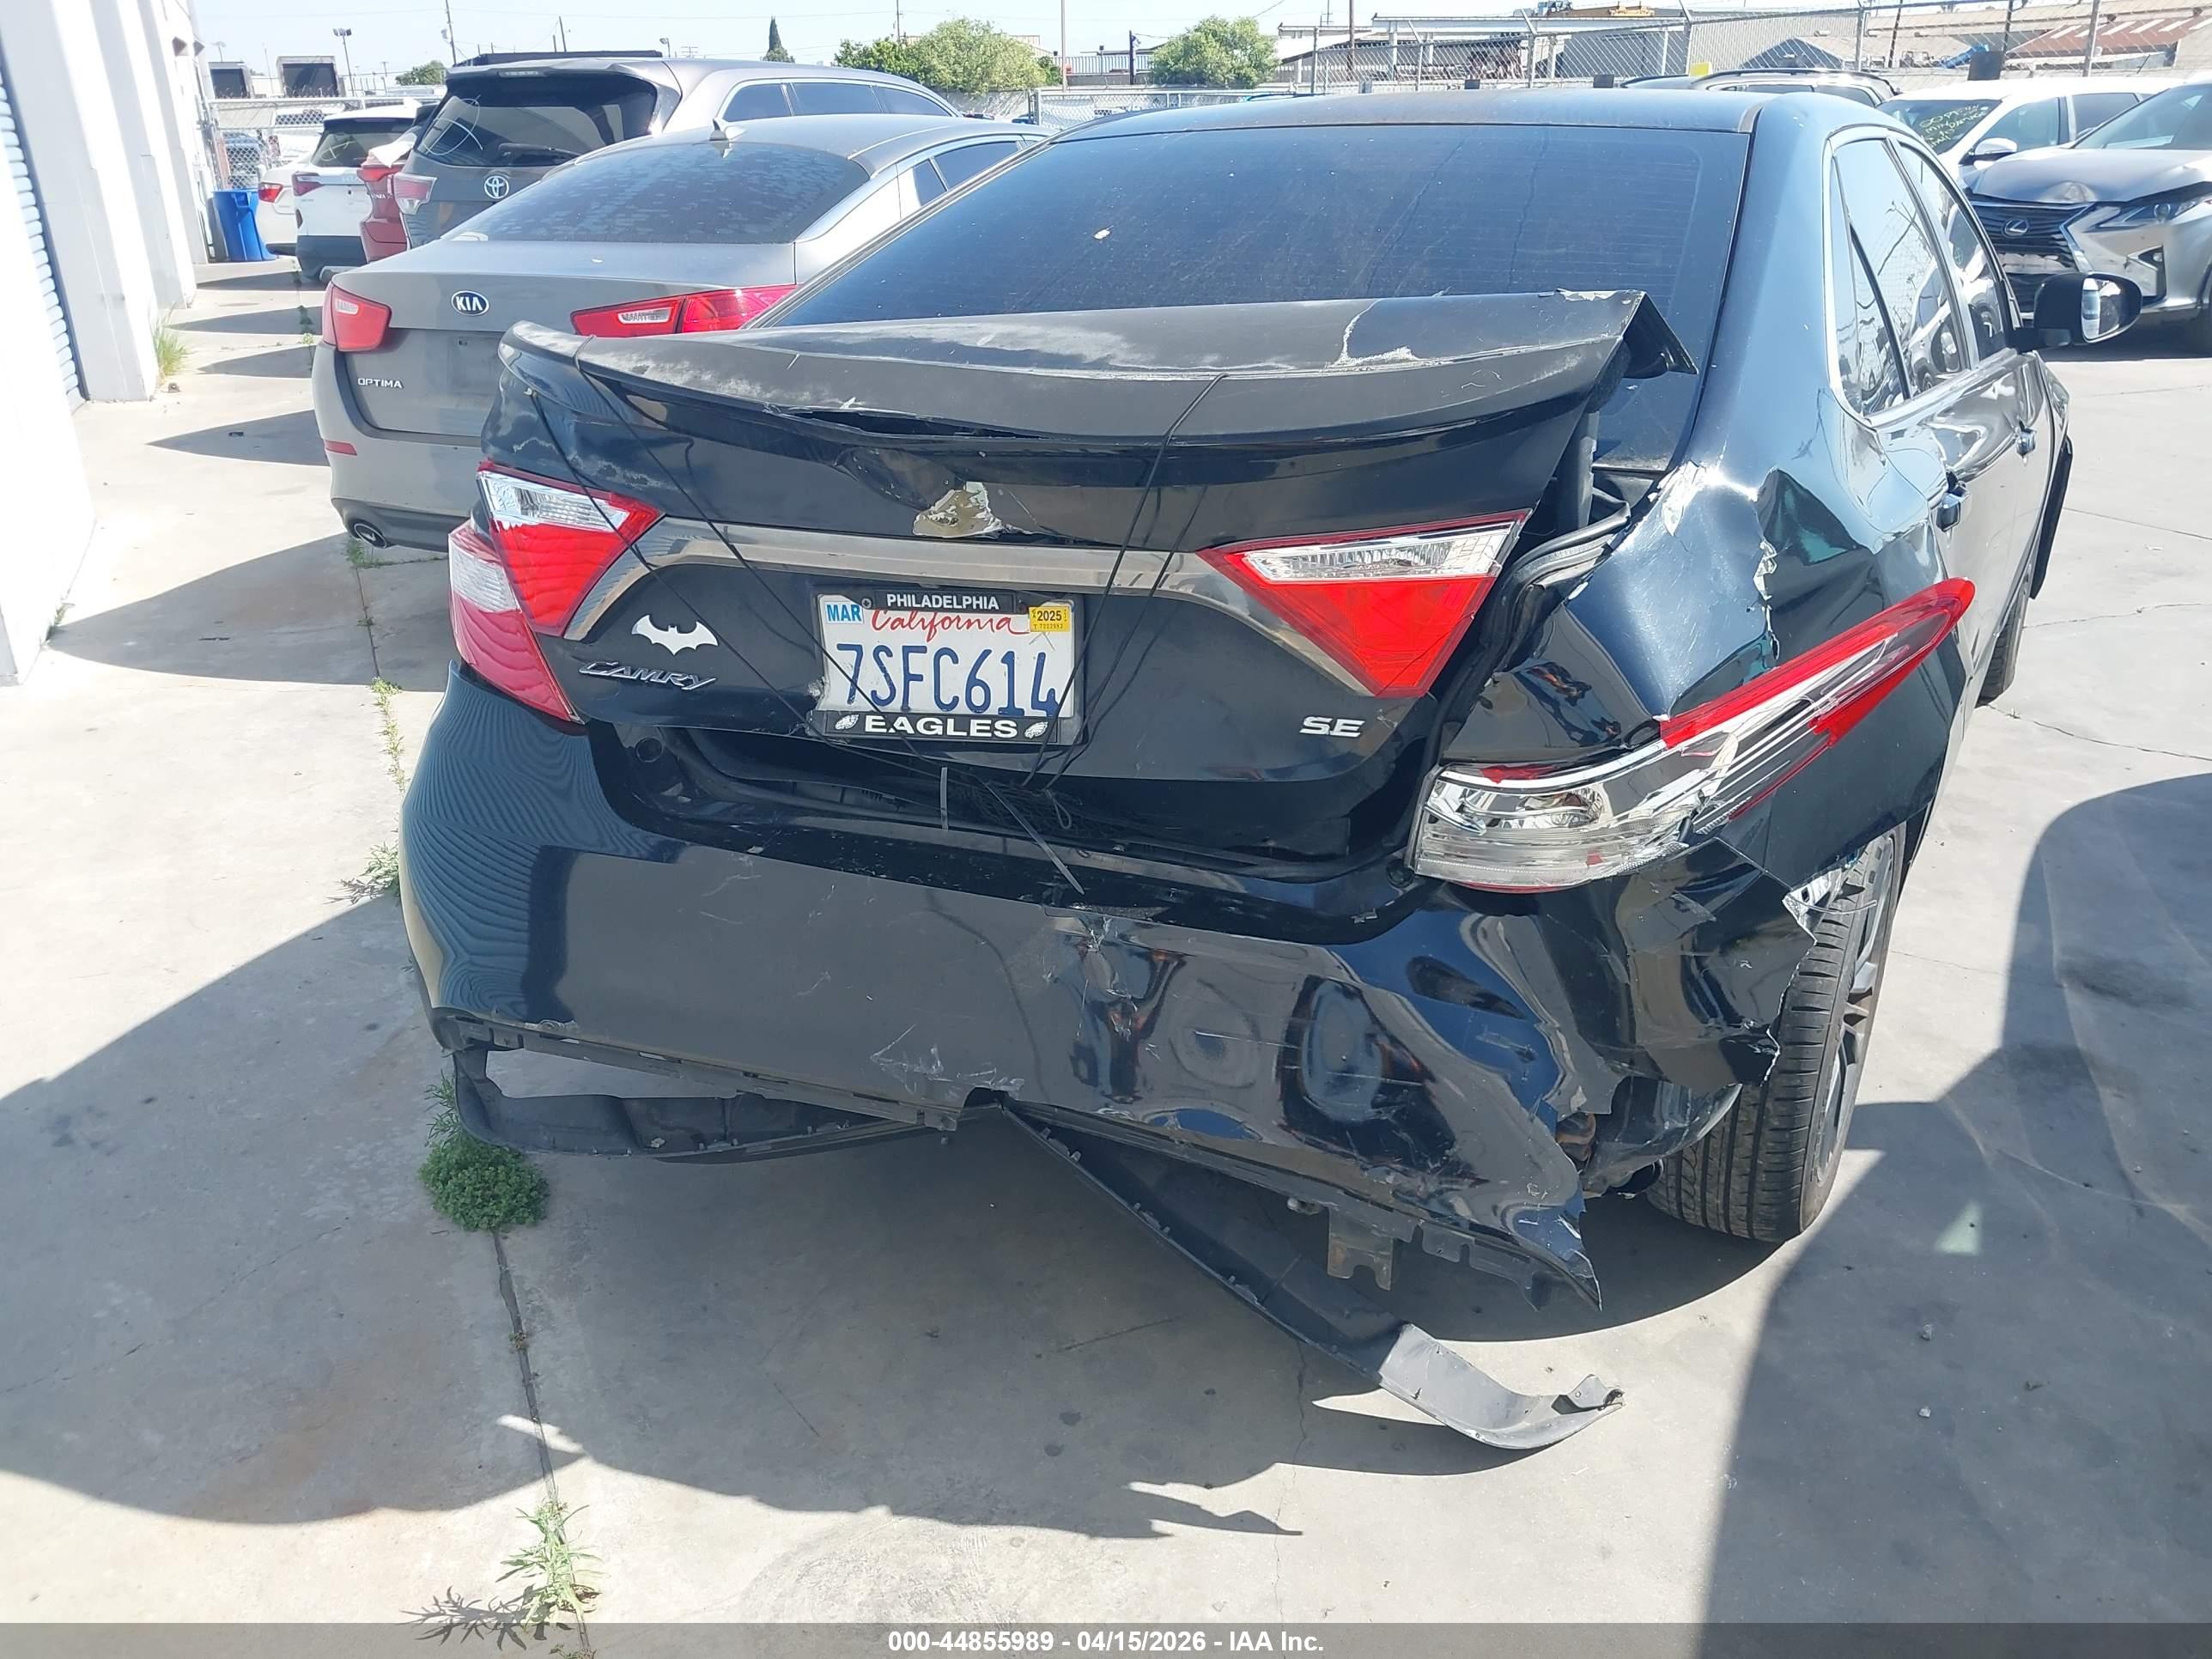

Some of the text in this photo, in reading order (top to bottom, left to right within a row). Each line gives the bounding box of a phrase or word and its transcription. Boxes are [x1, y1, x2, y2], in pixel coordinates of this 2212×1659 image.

[456, 296, 483, 311] KIA
[357, 378, 403, 389] OPTIMA
[886, 593, 999, 611] PHILADELPHIA
[827, 605, 862, 623] MAR
[1036, 611, 1062, 622] 2025
[872, 609, 1030, 642] California
[579, 661, 716, 690] CAMRY
[836, 643, 1059, 717] 7SFC614
[865, 714, 1018, 738] EAGLES
[1298, 716, 1365, 738] SE
